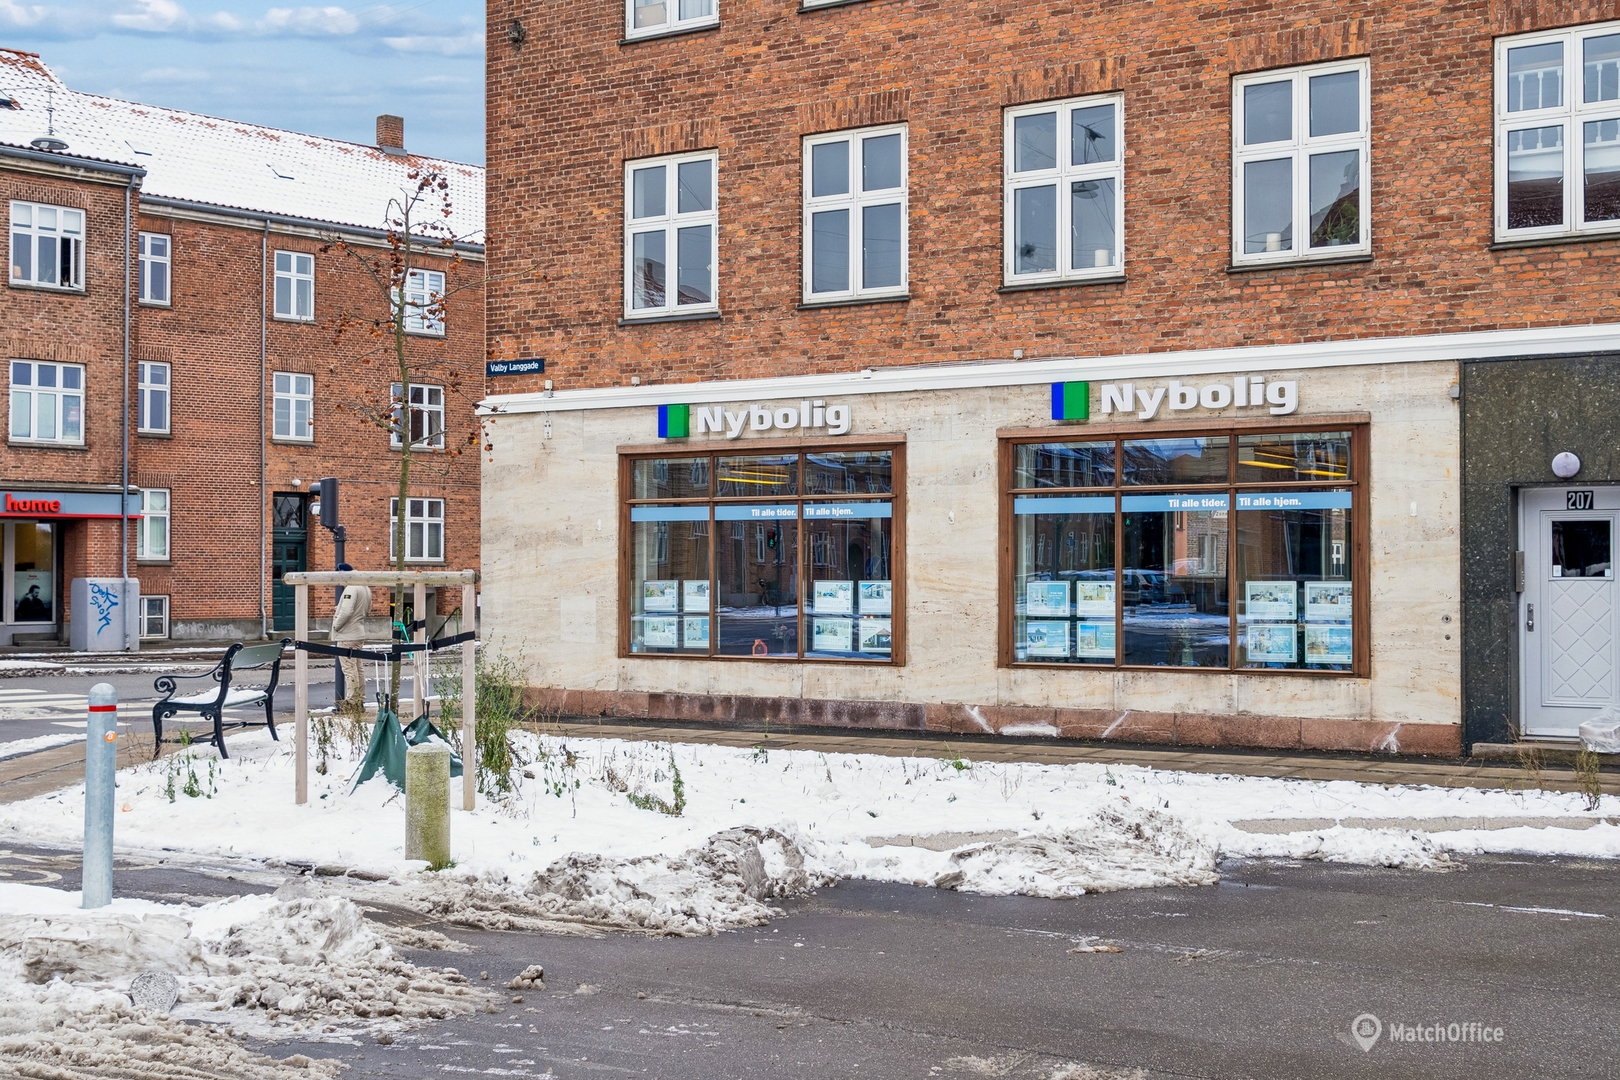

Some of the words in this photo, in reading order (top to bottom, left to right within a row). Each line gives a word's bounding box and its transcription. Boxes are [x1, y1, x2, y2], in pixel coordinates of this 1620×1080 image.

[490, 363, 508, 373] Valby
[509, 361, 539, 372] Langgade
[1101, 376, 1299, 421] Nybolig
[697, 400, 852, 440] Nybolig
[5, 493, 61, 513] home
[1168, 499, 1180, 508] Til
[1181, 499, 1200, 508] alle
[1202, 498, 1226, 508] tider.
[1239, 497, 1251, 506] Til
[1252, 497, 1272, 506] alle
[1274, 497, 1302, 508] hjem.
[1568, 492, 1592, 509] 207
[751, 509, 760, 517] Til
[761, 508, 775, 516] alle
[776, 508, 796, 516] tider.
[805, 507, 815, 516] Til
[816, 507, 830, 516] alle
[832, 508, 854, 516] hjem.
